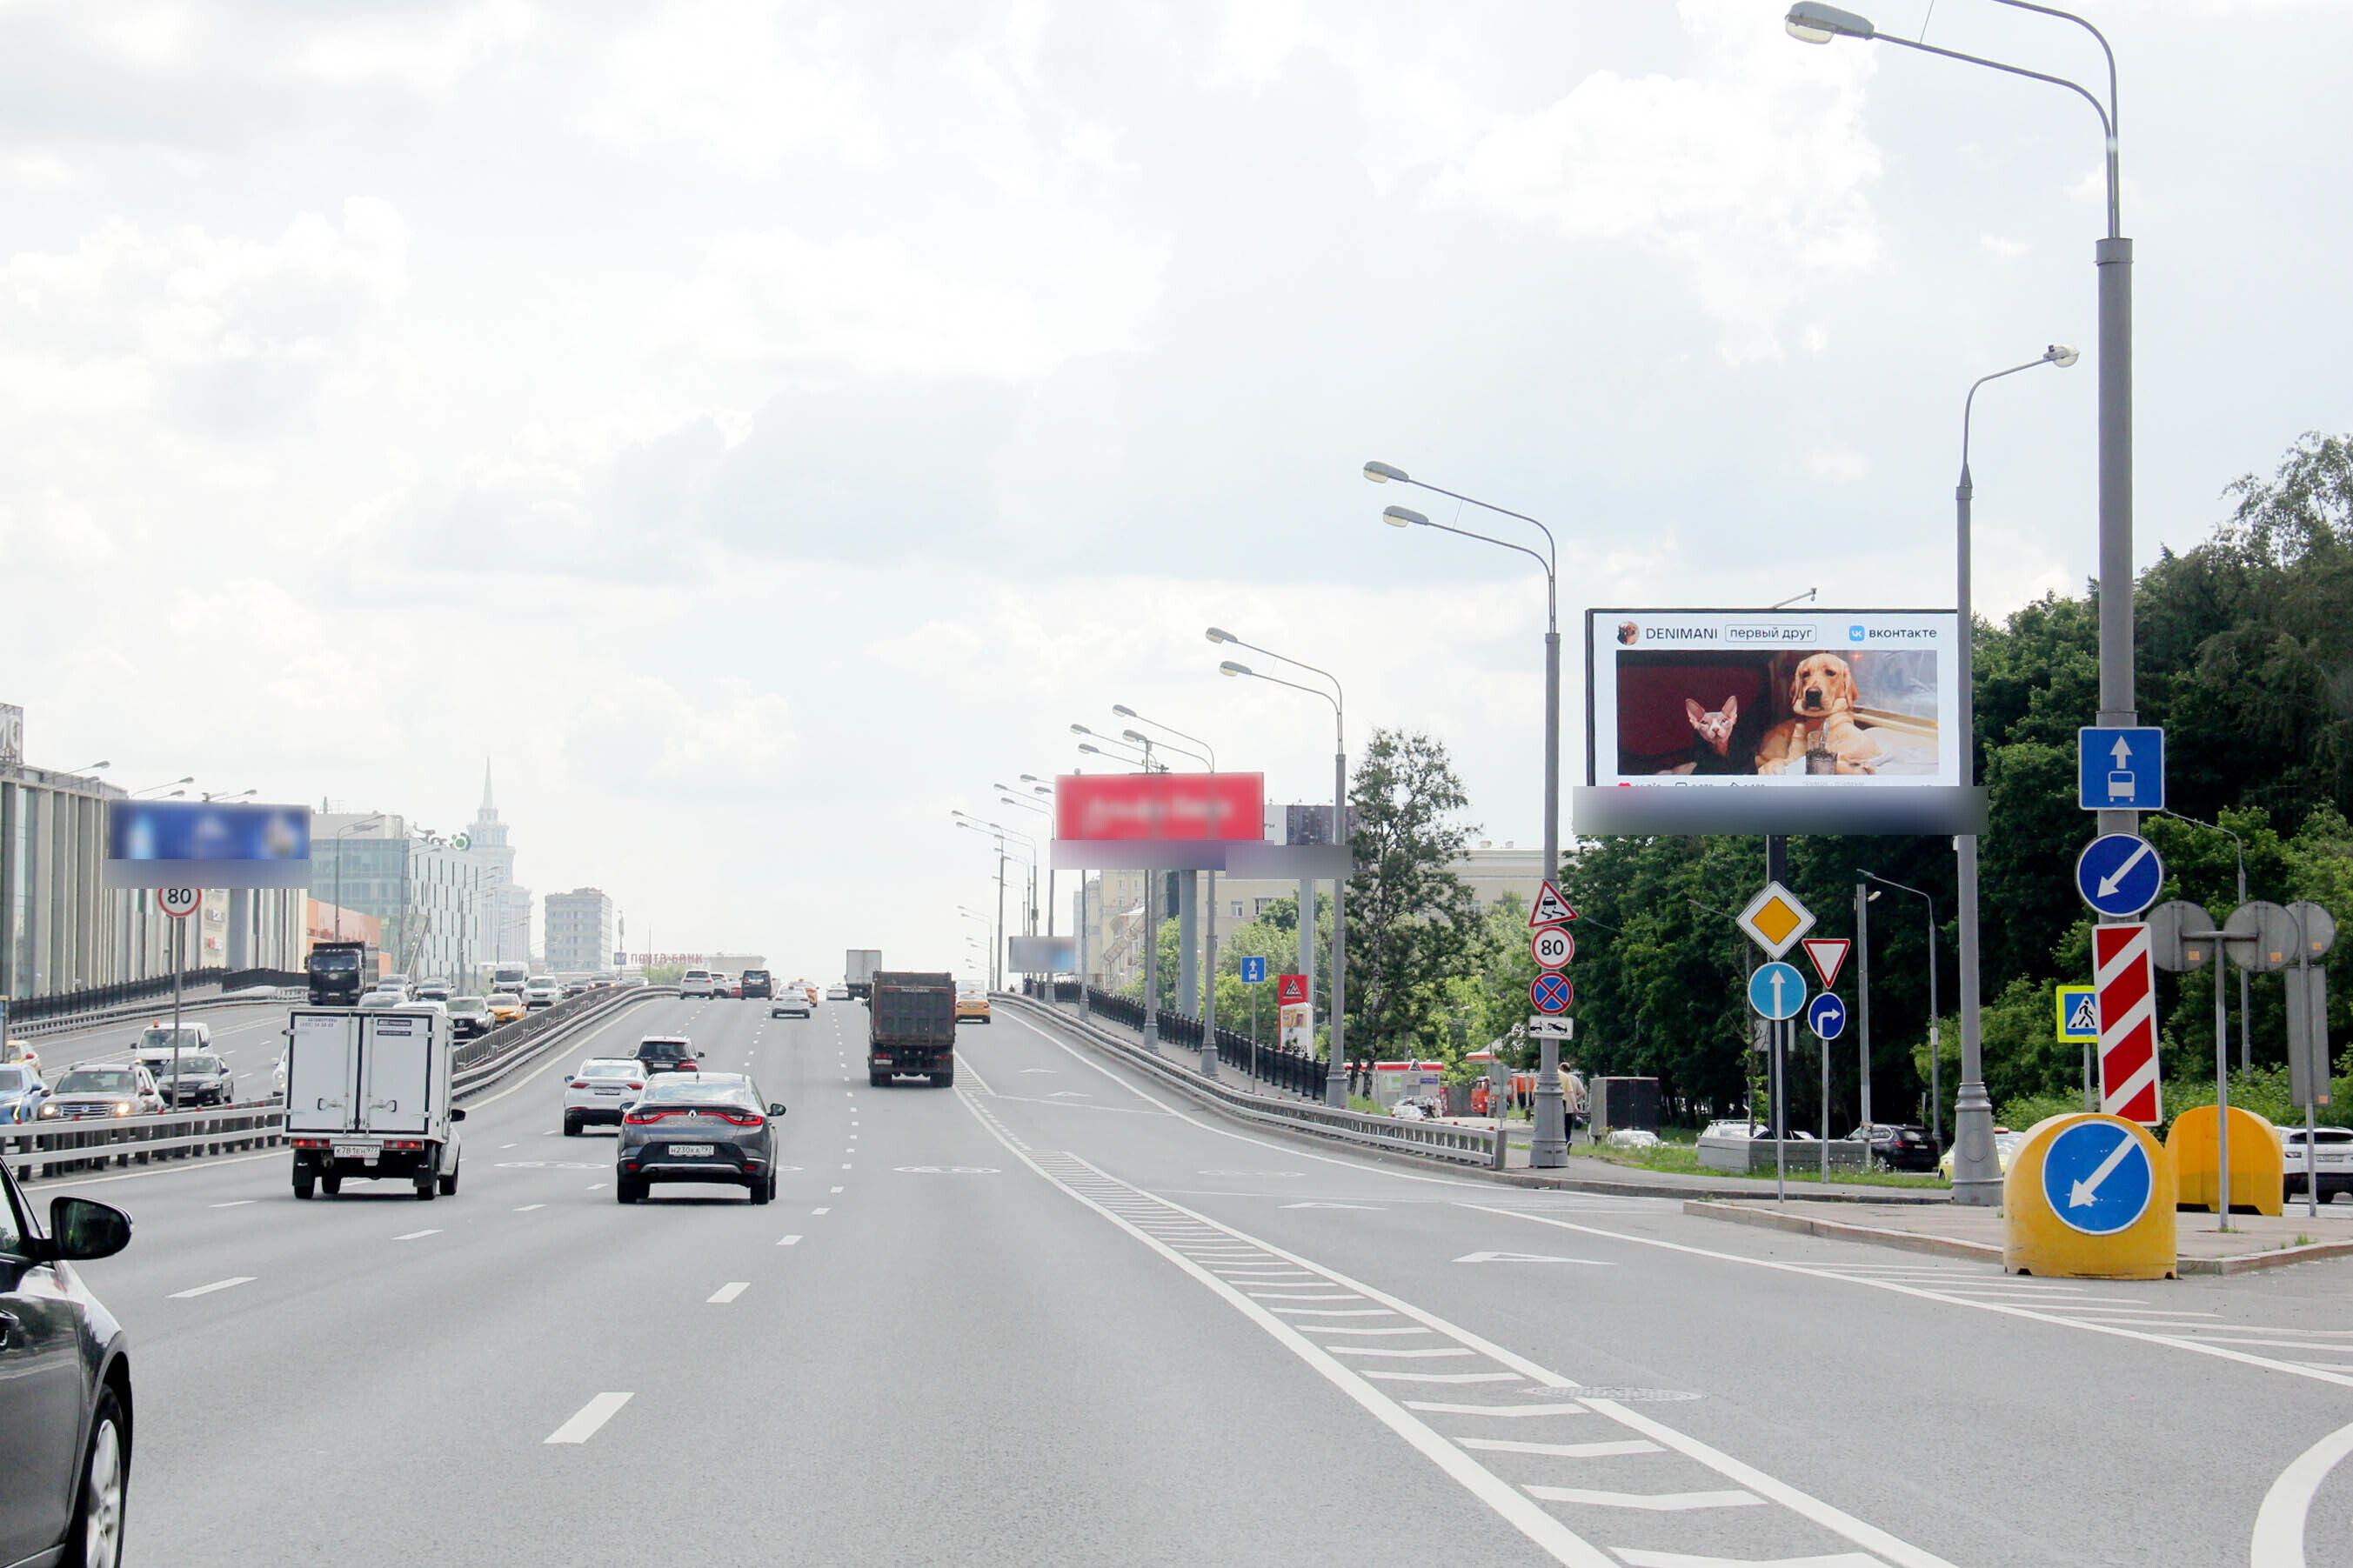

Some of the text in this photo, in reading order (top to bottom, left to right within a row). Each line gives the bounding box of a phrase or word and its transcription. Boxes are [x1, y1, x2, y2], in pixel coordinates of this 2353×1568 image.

[1646, 628, 1718, 639] DENIMANI
[1730, 627, 1813, 640] первый друг
[1868, 629, 1937, 638] вконтакте
[168, 889, 191, 904] 80
[1541, 939, 1564, 956] 80
